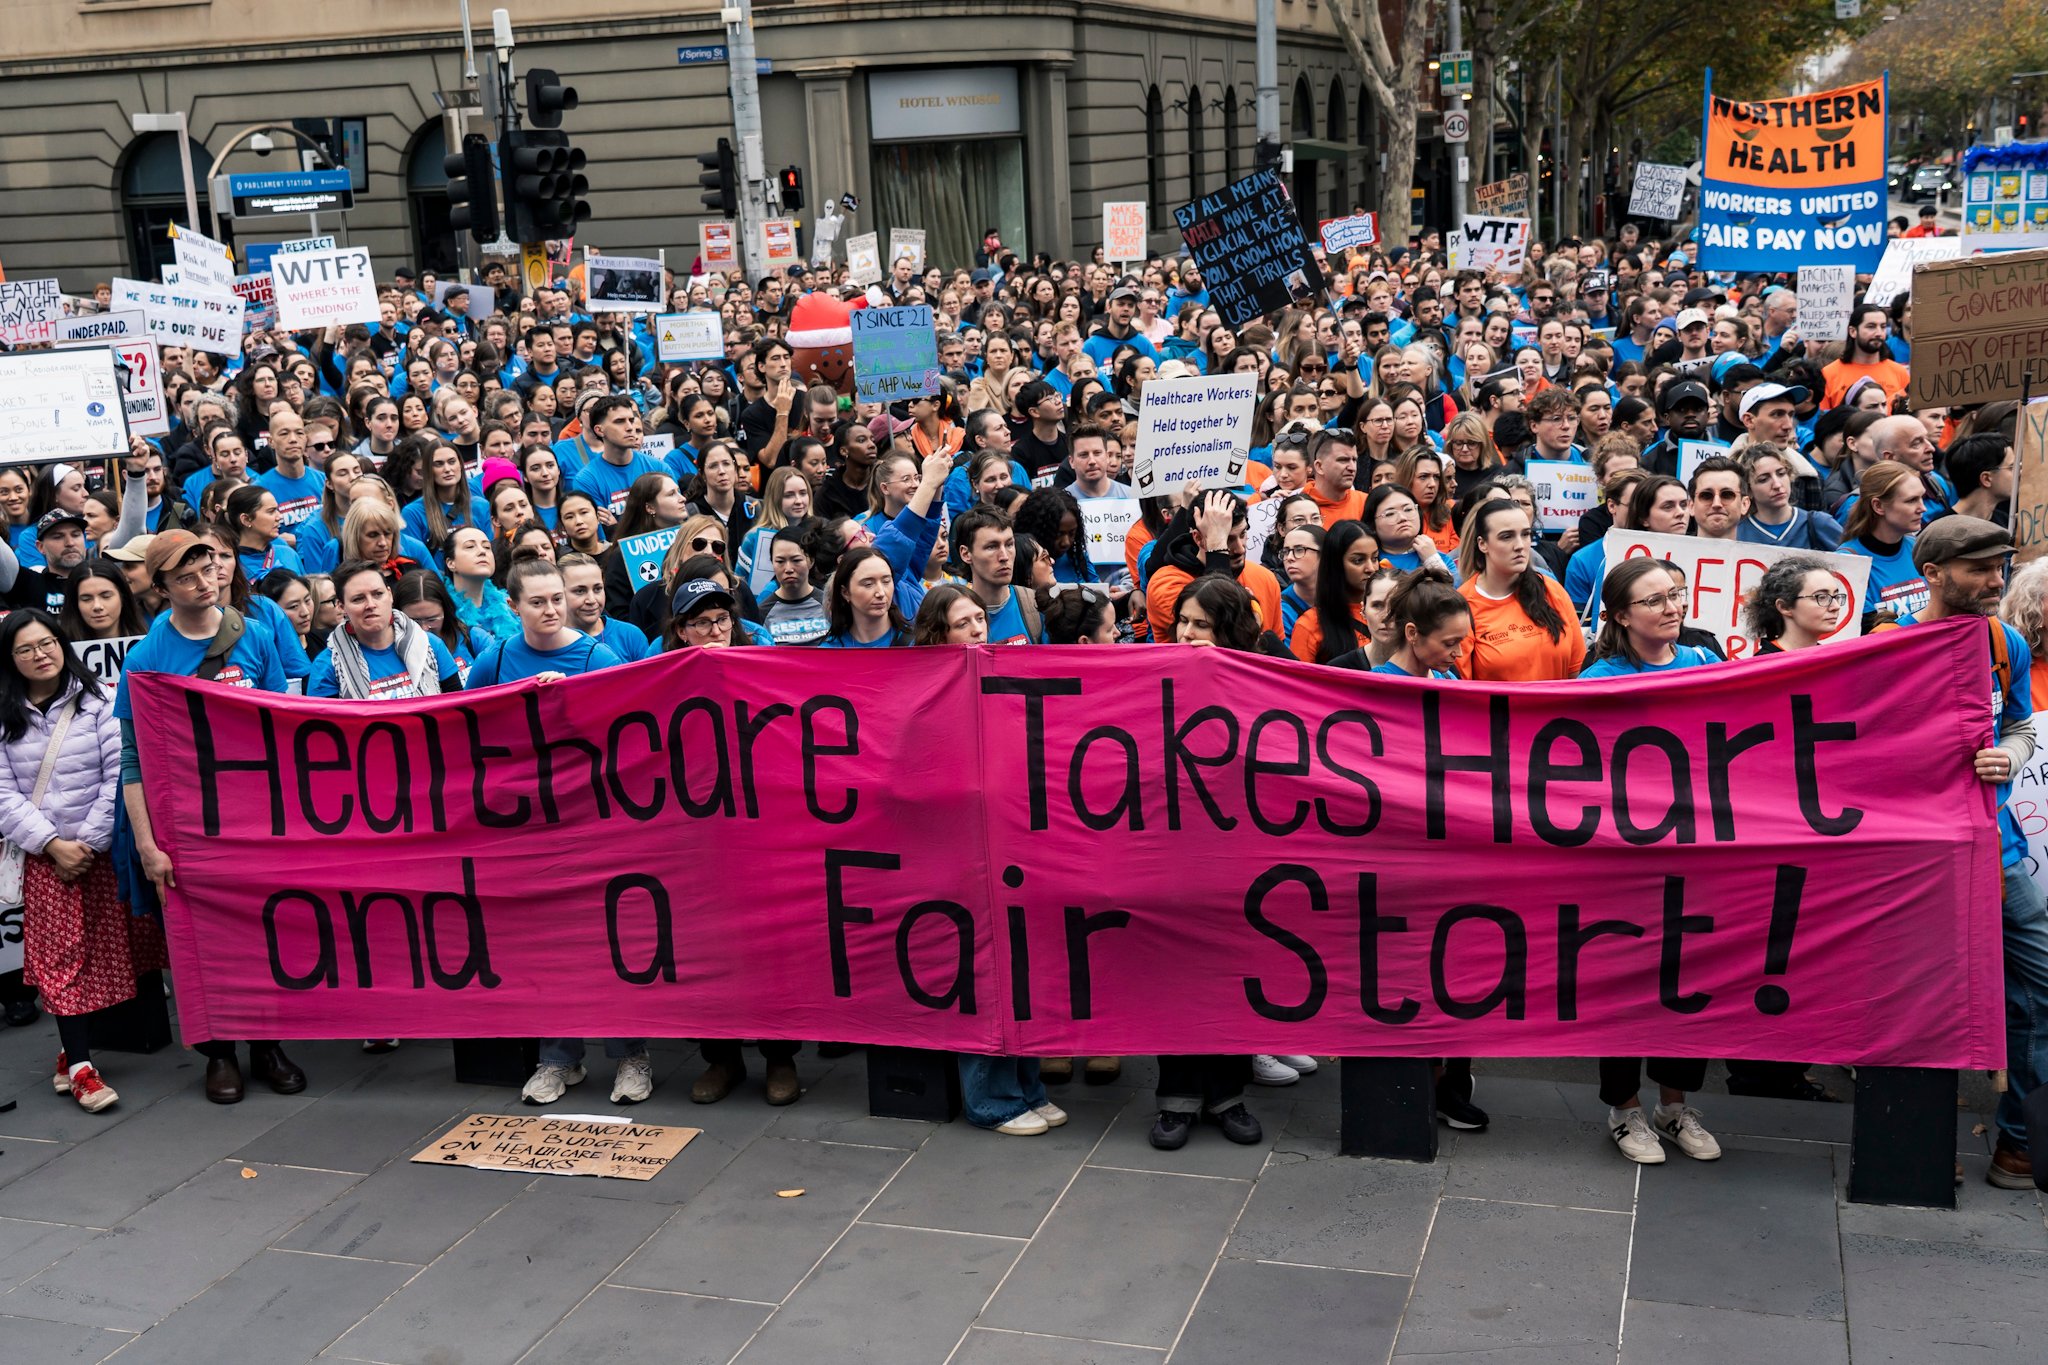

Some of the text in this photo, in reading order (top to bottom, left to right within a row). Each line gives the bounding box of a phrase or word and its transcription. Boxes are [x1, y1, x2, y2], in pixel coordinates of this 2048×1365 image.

[685, 48, 723, 60] Spring St
[898, 97, 944, 108] HOTEL
[1713, 88, 1882, 128] NORTHERN
[1447, 120, 1466, 132] 40
[1728, 141, 1856, 174] HEALTH
[1641, 165, 1683, 181] WANT
[244, 180, 285, 190] PARLIAMENT
[286, 179, 313, 188] STATION
[1475, 181, 1505, 200] YELLING
[1635, 177, 1682, 195] CARE?
[1174, 167, 1278, 228] BY ALL MEANS
[1478, 200, 1488, 210] TO
[1641, 190, 1672, 205] PAY
[1704, 190, 1879, 216] WORKERS UNITED
[1110, 204, 1138, 214] MAKE
[1222, 201, 1258, 231] MOVE
[1262, 188, 1282, 213] AT
[1109, 213, 1143, 226] ALLIED
[1323, 215, 1370, 239] Undervalued
[1109, 227, 1144, 239] HEALTH
[1194, 209, 1291, 268] A GLACIAL PACE
[1326, 228, 1372, 252] Underpaid
[1463, 220, 1528, 246] WTF!
[1756, 226, 1806, 251] PAY
[1814, 221, 1883, 251] NOW
[285, 238, 333, 253] RESPECT
[1109, 246, 1140, 257] AGAIN
[1888, 240, 1916, 250] NO
[1201, 226, 1304, 290] YOU KNOW HOW
[277, 253, 368, 286] WTF?
[1208, 249, 1306, 307] THAT THRILLS
[1800, 268, 1845, 282] JACINTA
[0, 281, 57, 300] EATHE
[232, 277, 272, 293] VALUE
[288, 285, 361, 303] WHERE'S THE
[1802, 281, 1846, 293] MAKES A
[1872, 280, 1897, 294] NO
[126, 290, 222, 311] WE SEE THRU YOU
[301, 301, 359, 317] FUNDING?
[1225, 294, 1263, 325] US!!
[1799, 296, 1839, 309] DOLLAR
[1, 309, 46, 328] PAY US
[866, 308, 929, 329] SINCE '21
[1799, 310, 1825, 321] ALLIED
[150, 318, 226, 342] US OUR DUE
[1800, 320, 1830, 330] MAKES
[1938, 337, 1977, 367] PAY
[858, 376, 922, 396] VIC AHP Wage
[1146, 387, 1253, 406] Healthcare Workers:
[1152, 413, 1239, 433] Held together by
[1153, 438, 1233, 460] professionalism
[1164, 465, 1219, 481] and coffee
[1562, 490, 1587, 500] Our
[1084, 513, 1131, 523] No Plan?
[770, 617, 828, 635] RESPECT
[185, 676, 1864, 848] Healthcare Takes Heart
[261, 849, 1808, 1026] and a Fair Start!
[469, 1115, 665, 1138] STOP BALANCING
[440, 1141, 483, 1151] ON
[464, 1129, 653, 1151] THE BUDGET
[502, 1155, 580, 1170] BACKS
